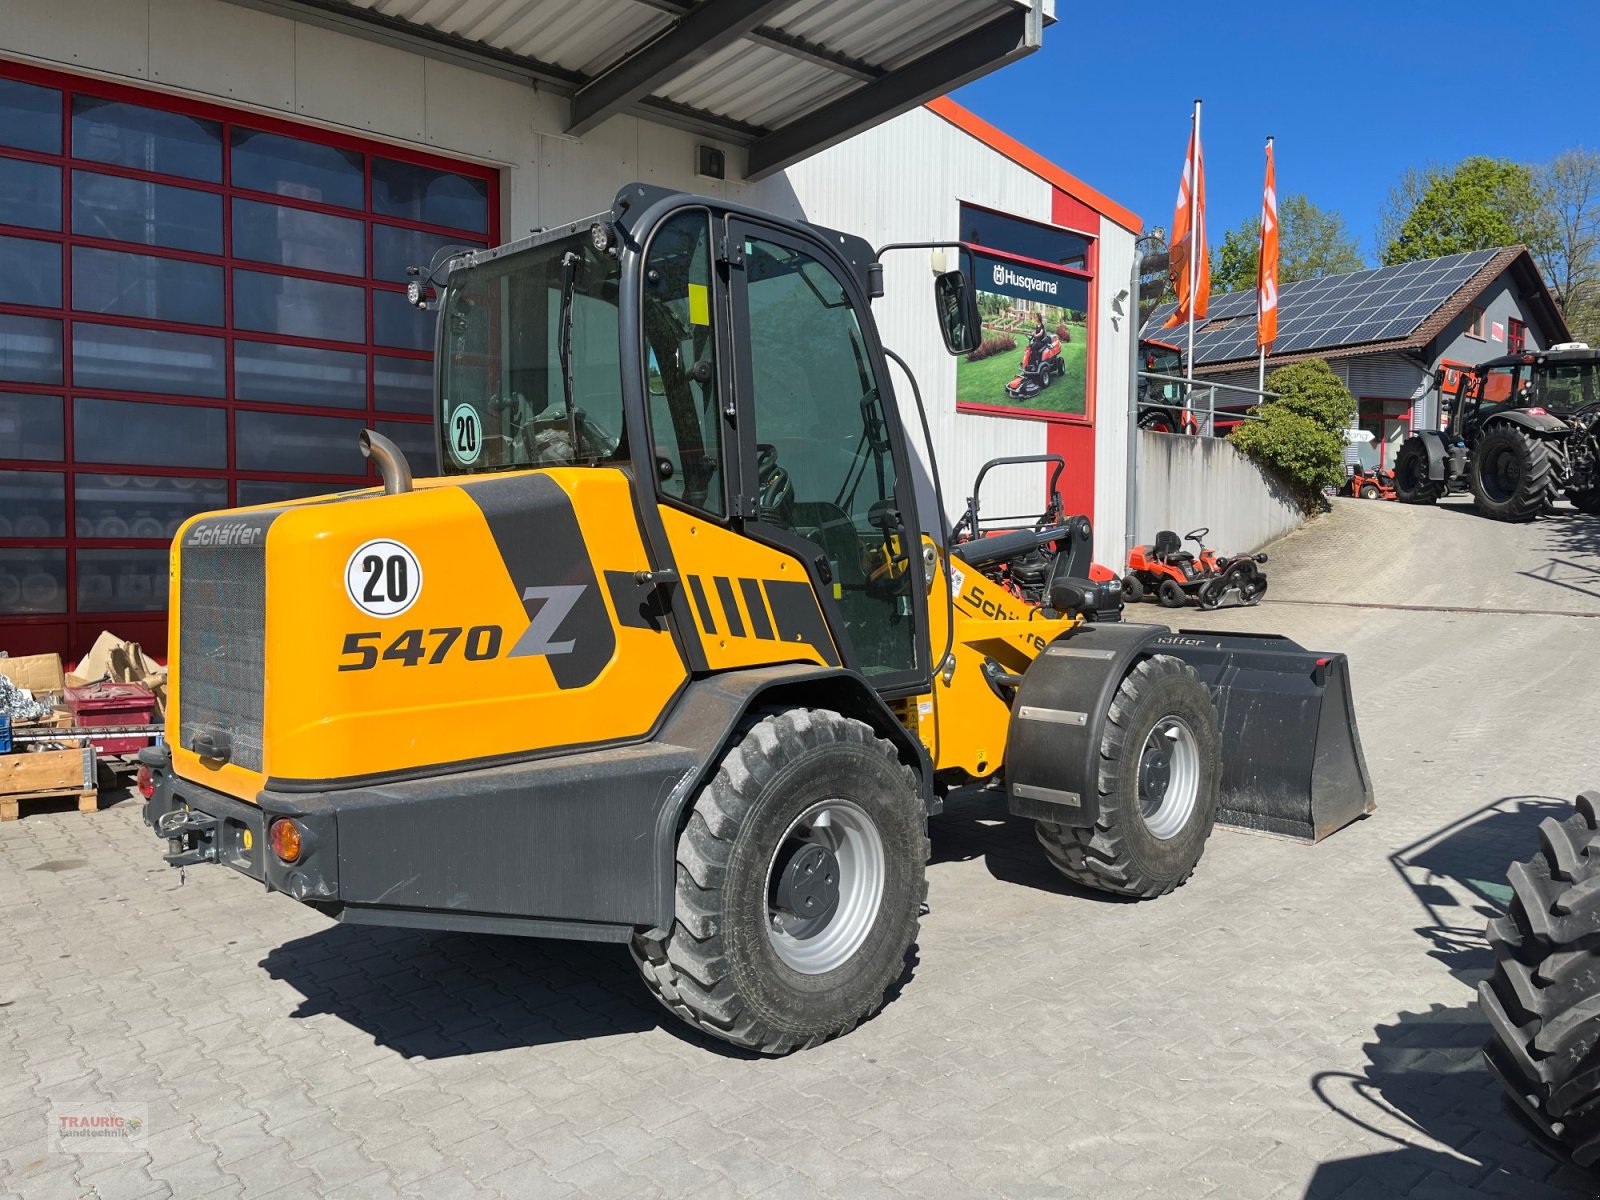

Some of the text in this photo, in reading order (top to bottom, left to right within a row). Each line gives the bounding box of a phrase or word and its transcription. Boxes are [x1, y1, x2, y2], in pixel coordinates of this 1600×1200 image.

[1005, 269, 1058, 295] Husqvarna
[457, 415, 476, 452] 20
[188, 523, 261, 546] Schäffer
[362, 554, 408, 603] 20
[338, 584, 588, 672] 5470 Z
